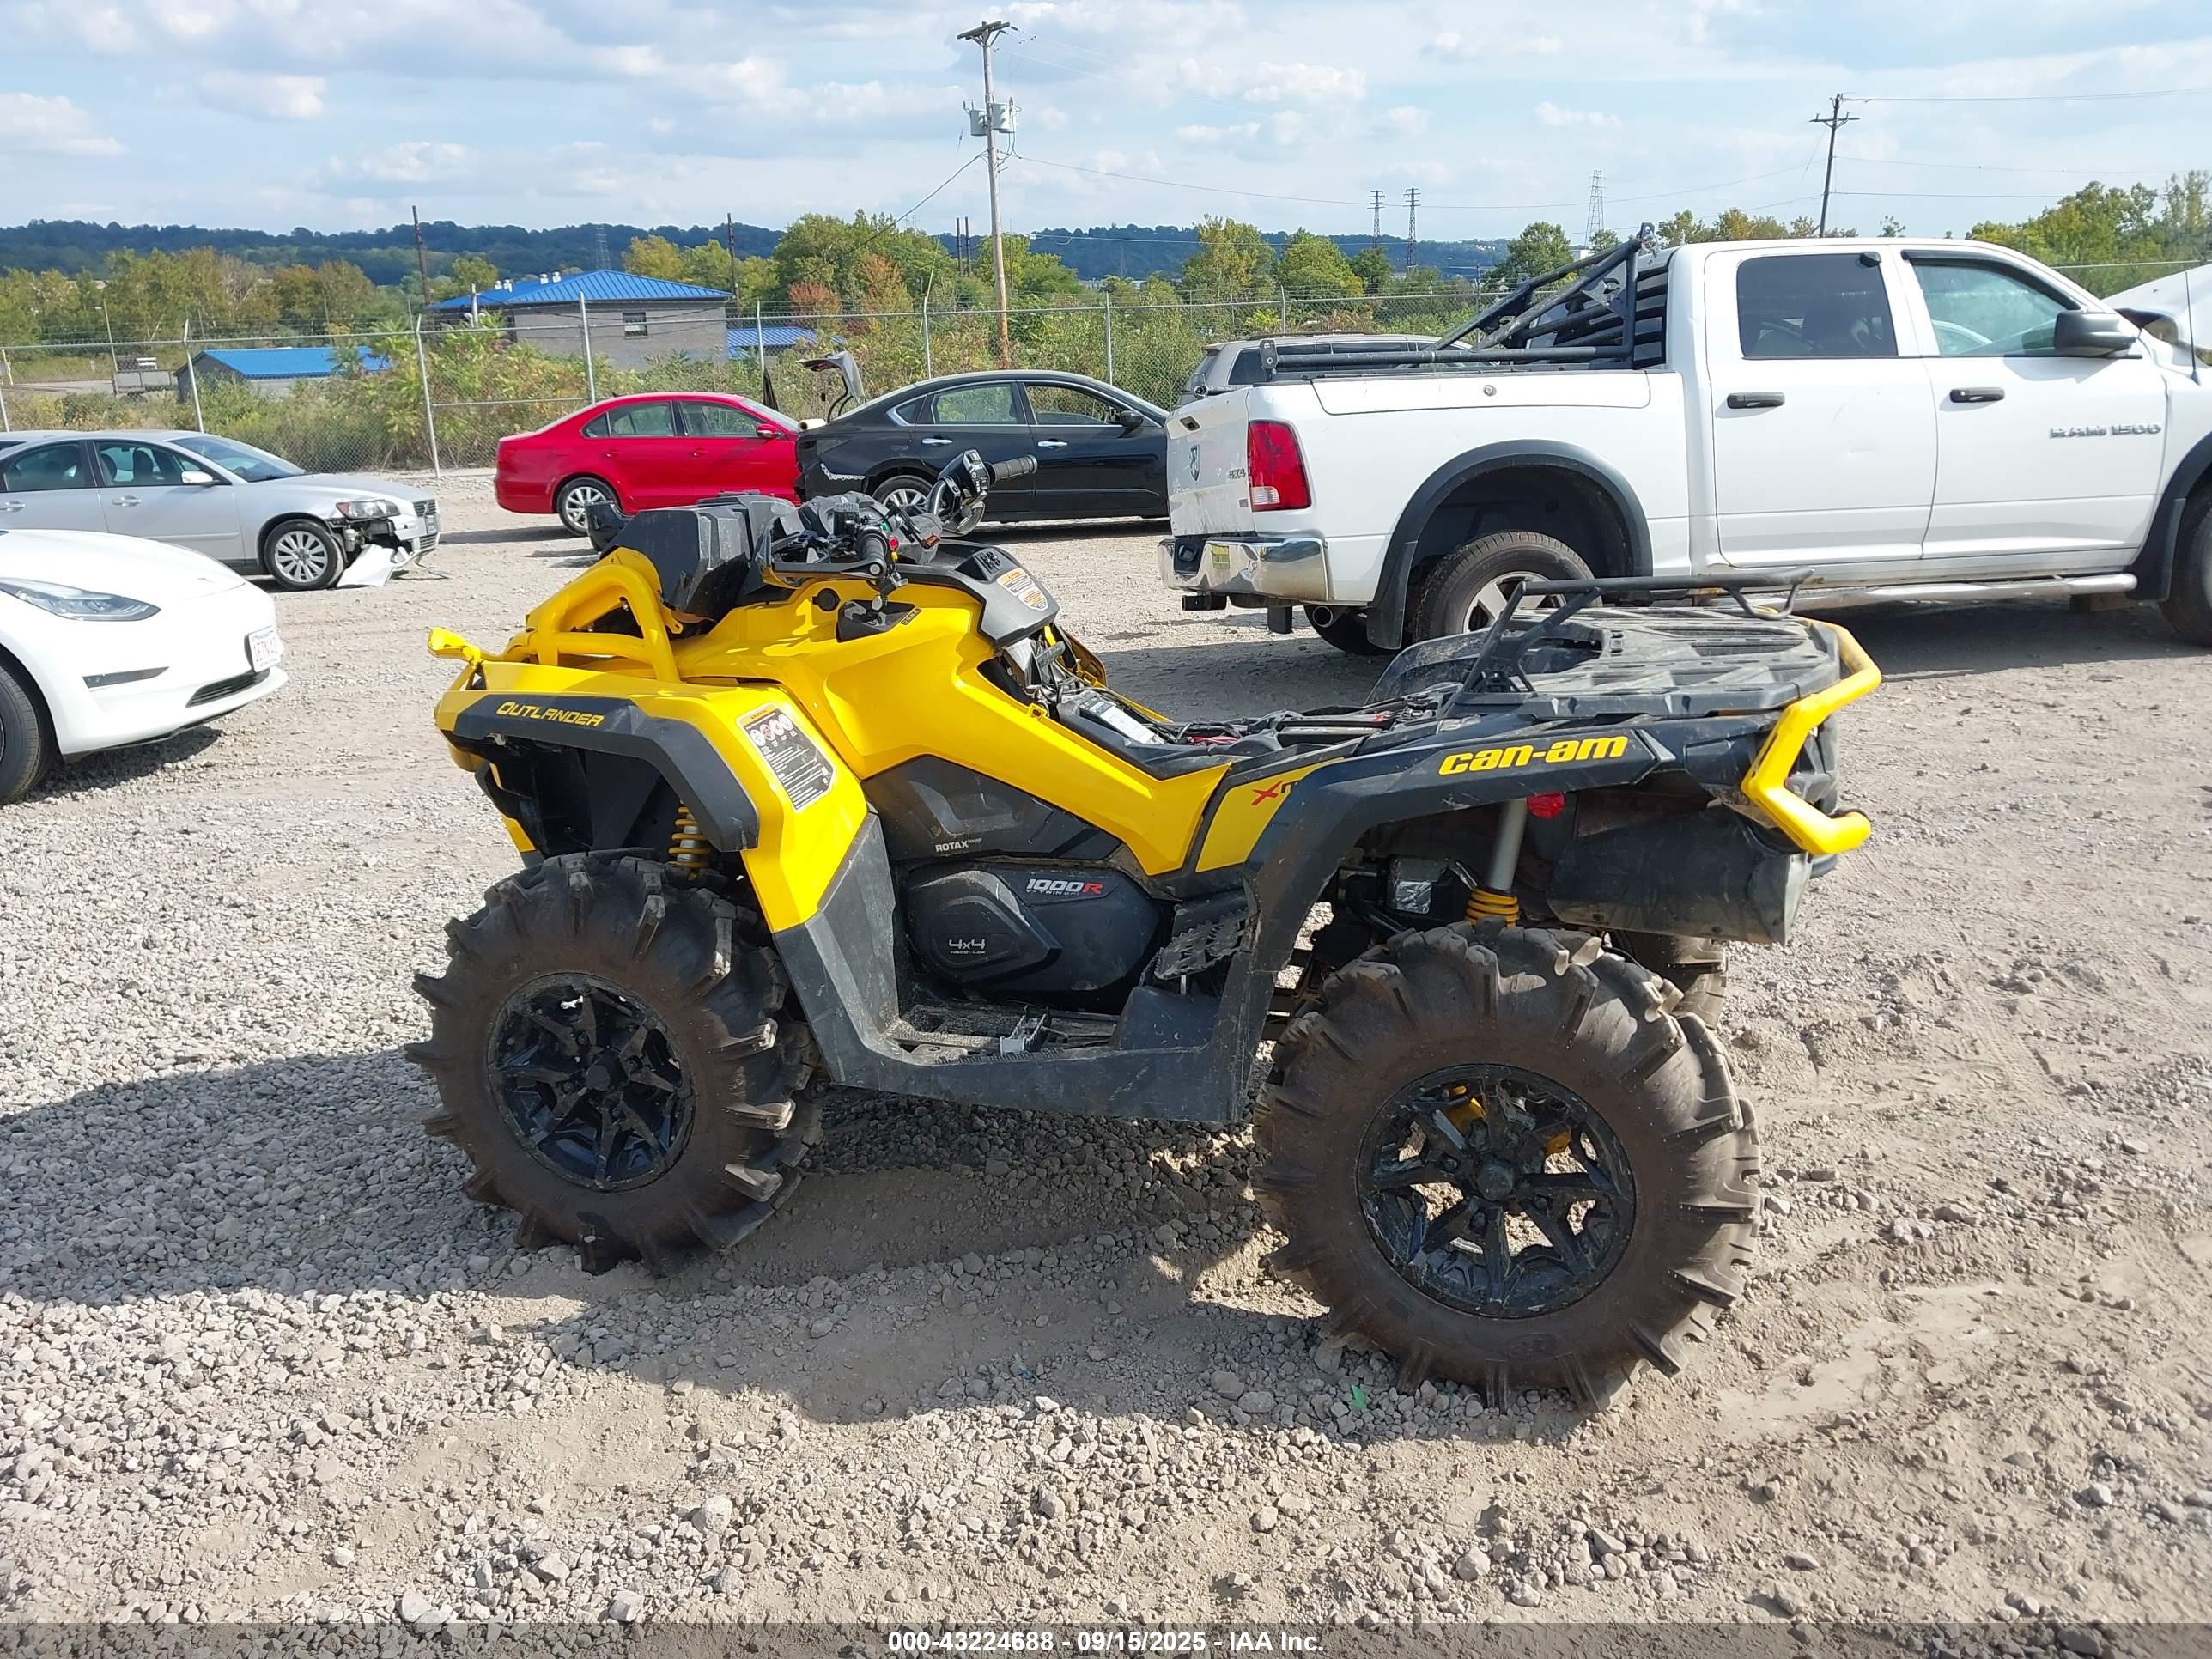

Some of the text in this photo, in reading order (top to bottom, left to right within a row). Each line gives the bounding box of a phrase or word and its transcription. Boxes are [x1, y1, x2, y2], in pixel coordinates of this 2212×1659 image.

[2050, 423, 2162, 439] RAM 1500
[495, 701, 605, 727] OUTLANDER
[1438, 735, 1629, 776] can-am
[934, 840, 969, 853] ROTAX
[1025, 878, 1104, 894] 1000R
